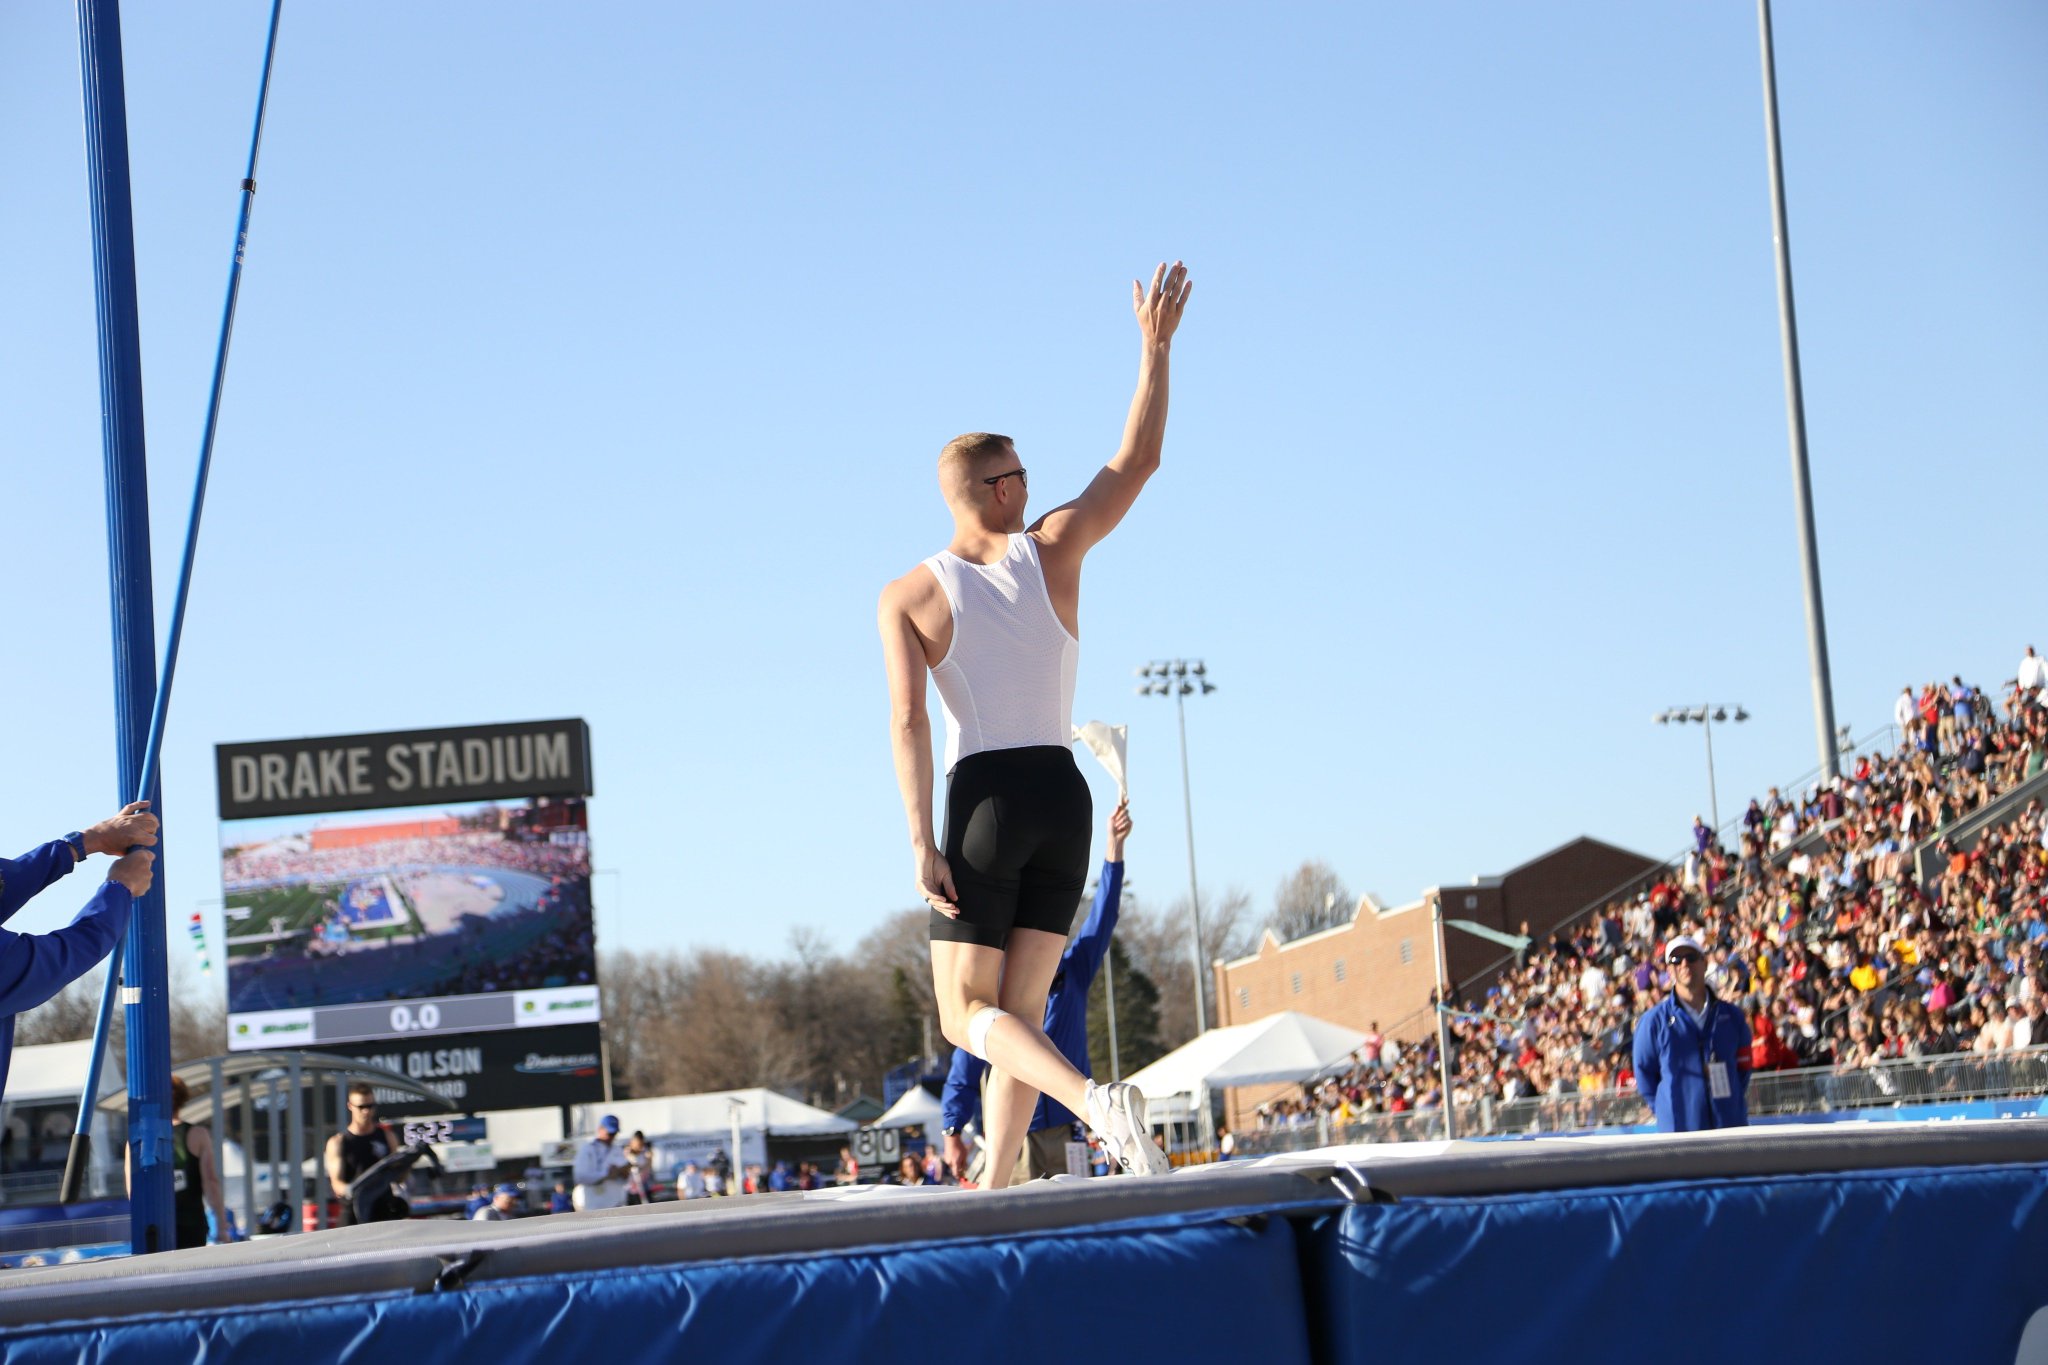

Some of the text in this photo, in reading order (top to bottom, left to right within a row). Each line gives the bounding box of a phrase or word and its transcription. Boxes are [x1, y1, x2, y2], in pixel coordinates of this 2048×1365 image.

[230, 731, 571, 803] DRAKE STADIUM
[390, 1004, 440, 1031] 0.0
[407, 1047, 482, 1079] OLSON
[403, 1120, 454, 1146] 6:22
[858, 1129, 896, 1156] 80
